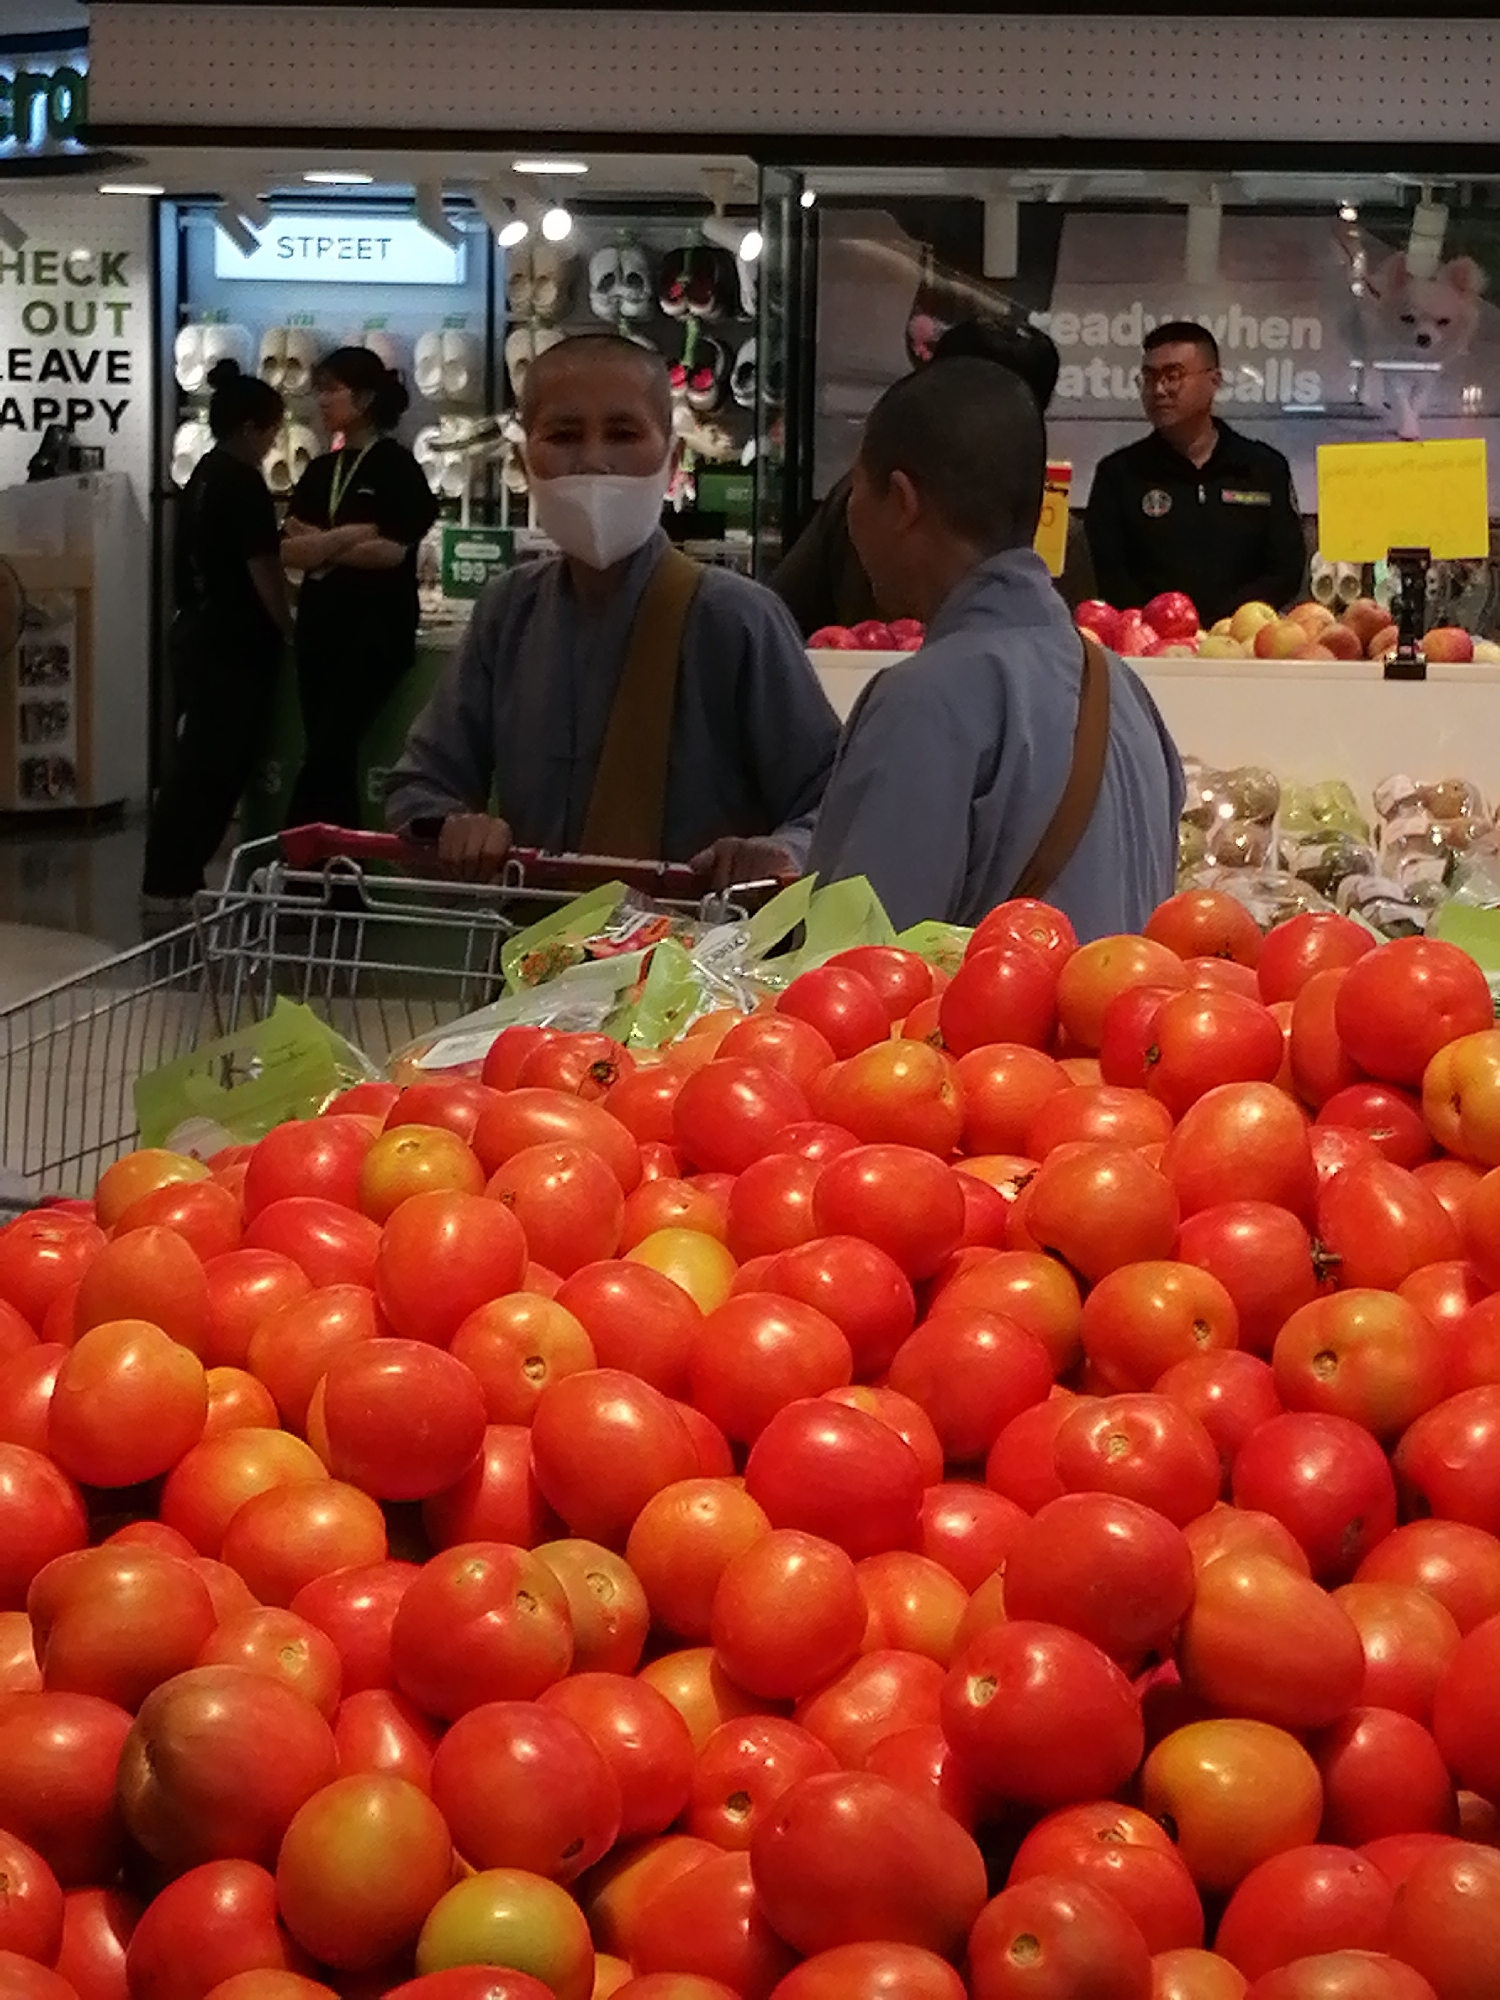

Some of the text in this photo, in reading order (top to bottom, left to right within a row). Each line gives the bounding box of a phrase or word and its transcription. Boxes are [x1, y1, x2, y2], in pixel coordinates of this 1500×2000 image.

[276, 236, 392, 260] STREET
[22, 300, 132, 337] OUT
[0, 348, 131, 384] EAVE
